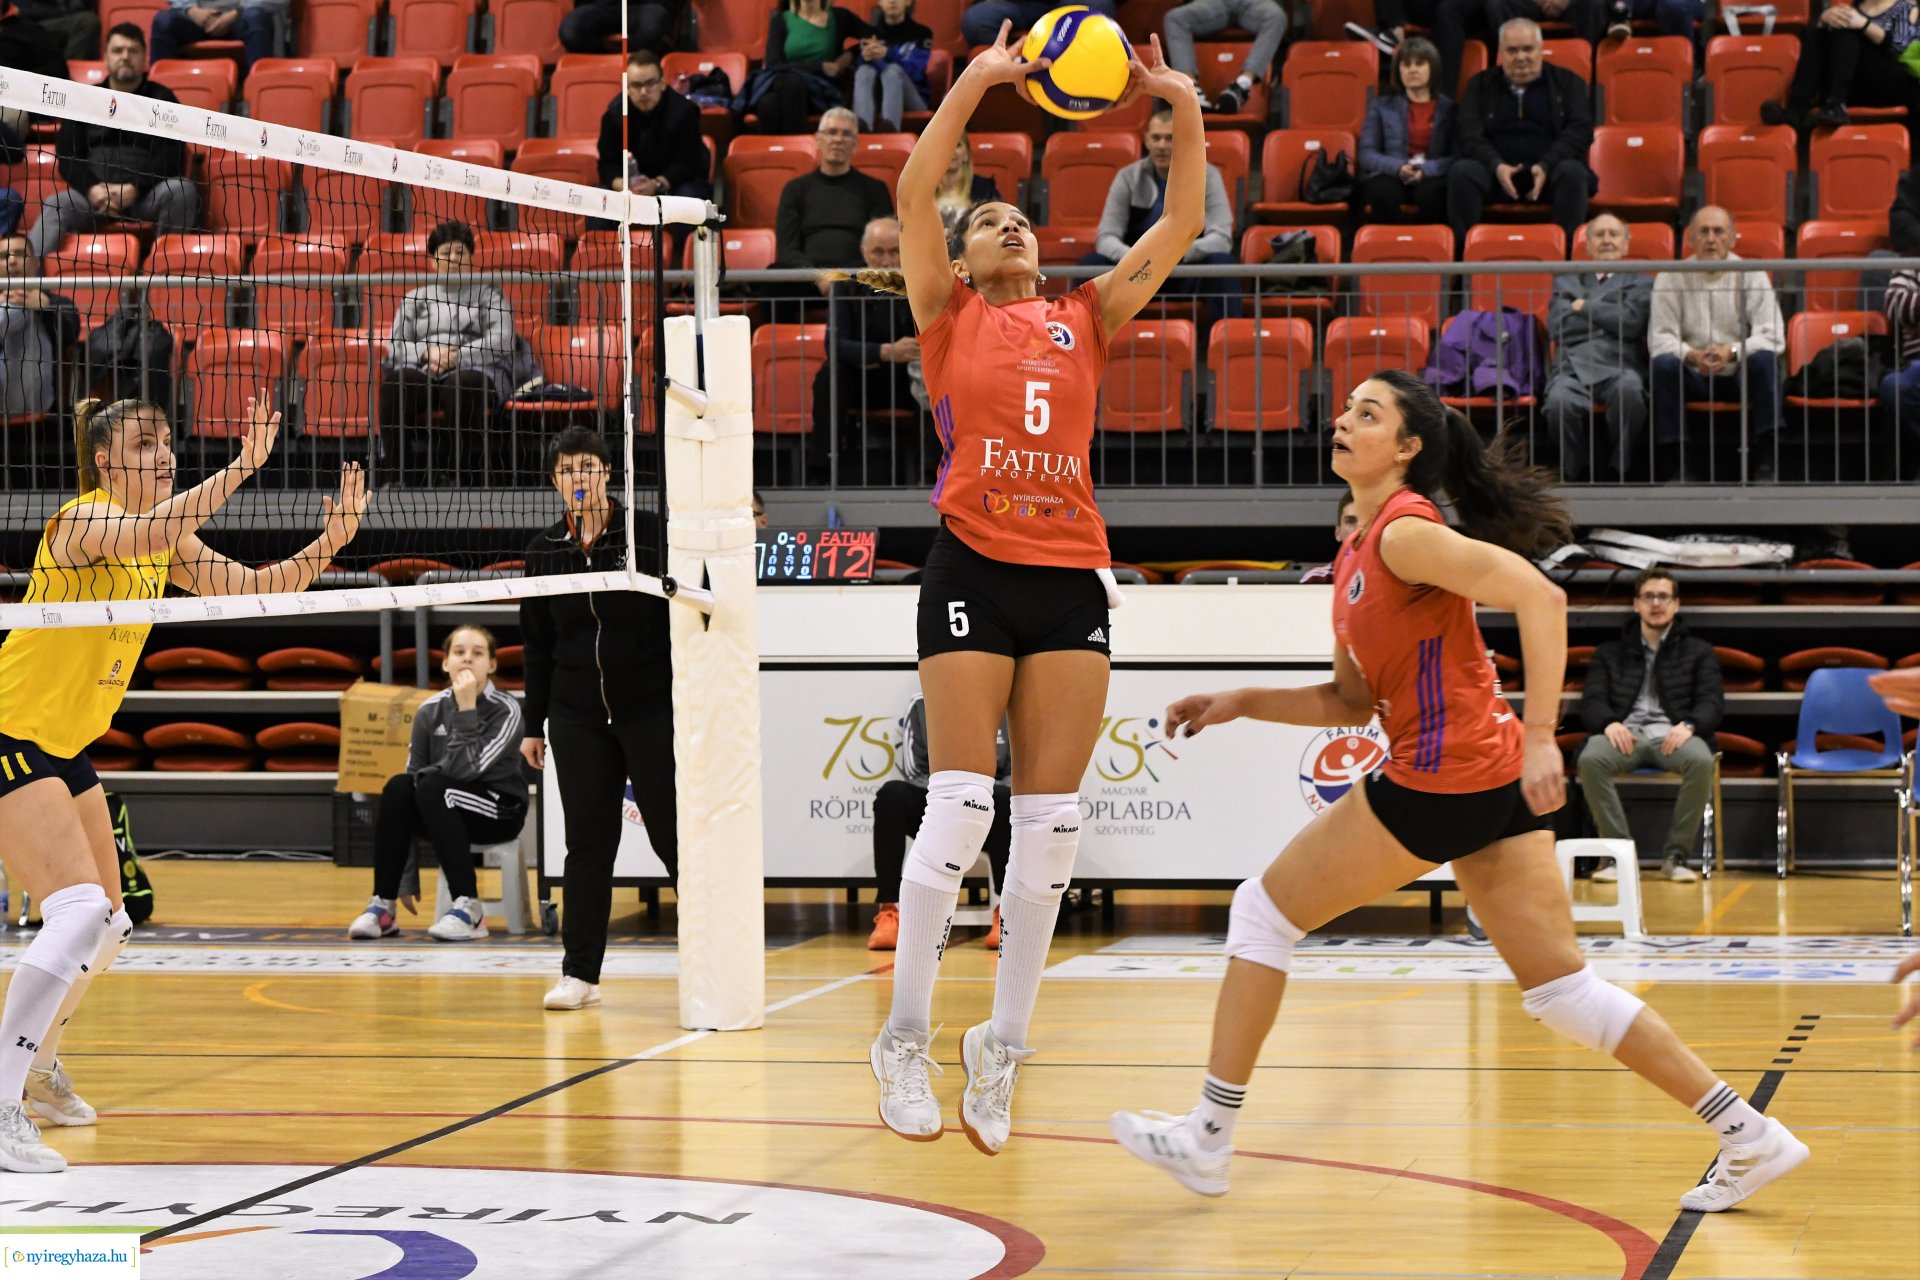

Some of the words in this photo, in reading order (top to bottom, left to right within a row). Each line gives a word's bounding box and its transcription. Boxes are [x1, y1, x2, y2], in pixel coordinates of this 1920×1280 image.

[42, 83, 67, 106] FATUM
[205, 116, 227, 138] FATUM
[1024, 380, 1050, 435] 5
[980, 436, 1081, 478] FATUM
[980, 468, 1083, 486] PROPERT
[1013, 493, 1064, 504] NYÍREGYHÁZA
[820, 531, 875, 545] FATUM
[822, 546, 870, 578] 12
[948, 601, 970, 637] 5
[823, 716, 895, 781] 75
[851, 786, 881, 795] MAG
[1101, 786, 1148, 796] MAGYAR
[810, 795, 872, 819] RÖPL
[1078, 796, 1192, 820] ÖPLABDA
[1095, 825, 1155, 836] SZÖVETSÉG
